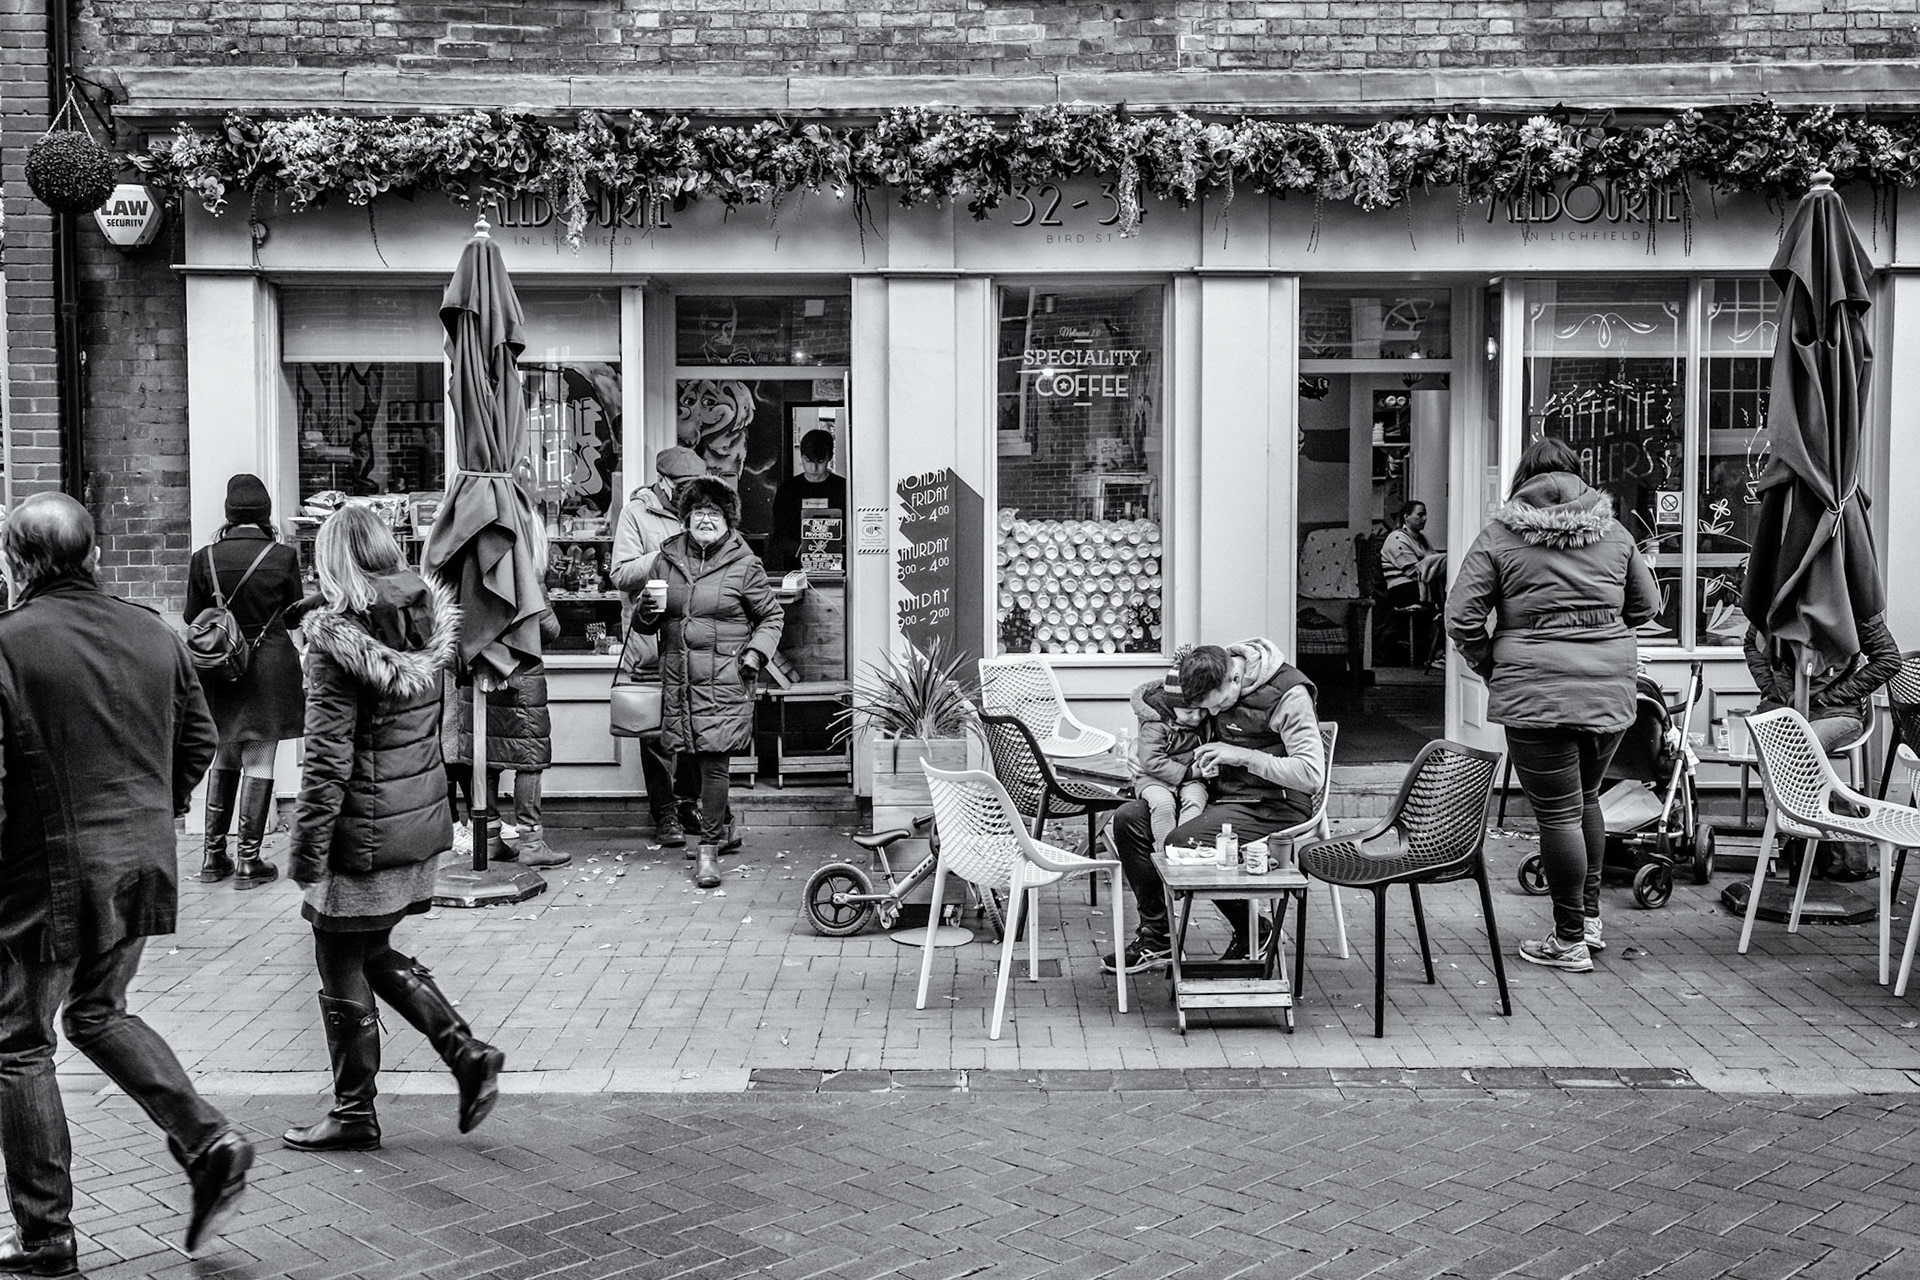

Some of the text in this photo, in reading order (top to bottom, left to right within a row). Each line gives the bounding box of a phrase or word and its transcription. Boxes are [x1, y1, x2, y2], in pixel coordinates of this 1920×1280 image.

[101, 200, 148, 216] LAW
[1011, 182, 1063, 226] 32
[106, 218, 144, 227] SECURITY
[514, 235, 633, 247] IN LICFIELD
[1046, 233, 1112, 243] BIRD ST
[1551, 231, 1641, 241] LICHFIELD
[1023, 349, 1142, 366] SPECIALITY
[1035, 374, 1129, 397] COFFEE
[1579, 437, 1654, 487] ALERS
[911, 485, 950, 508] FRIDAY
[897, 537, 950, 563] SATURDAY
[897, 588, 950, 612] SUNDAY
